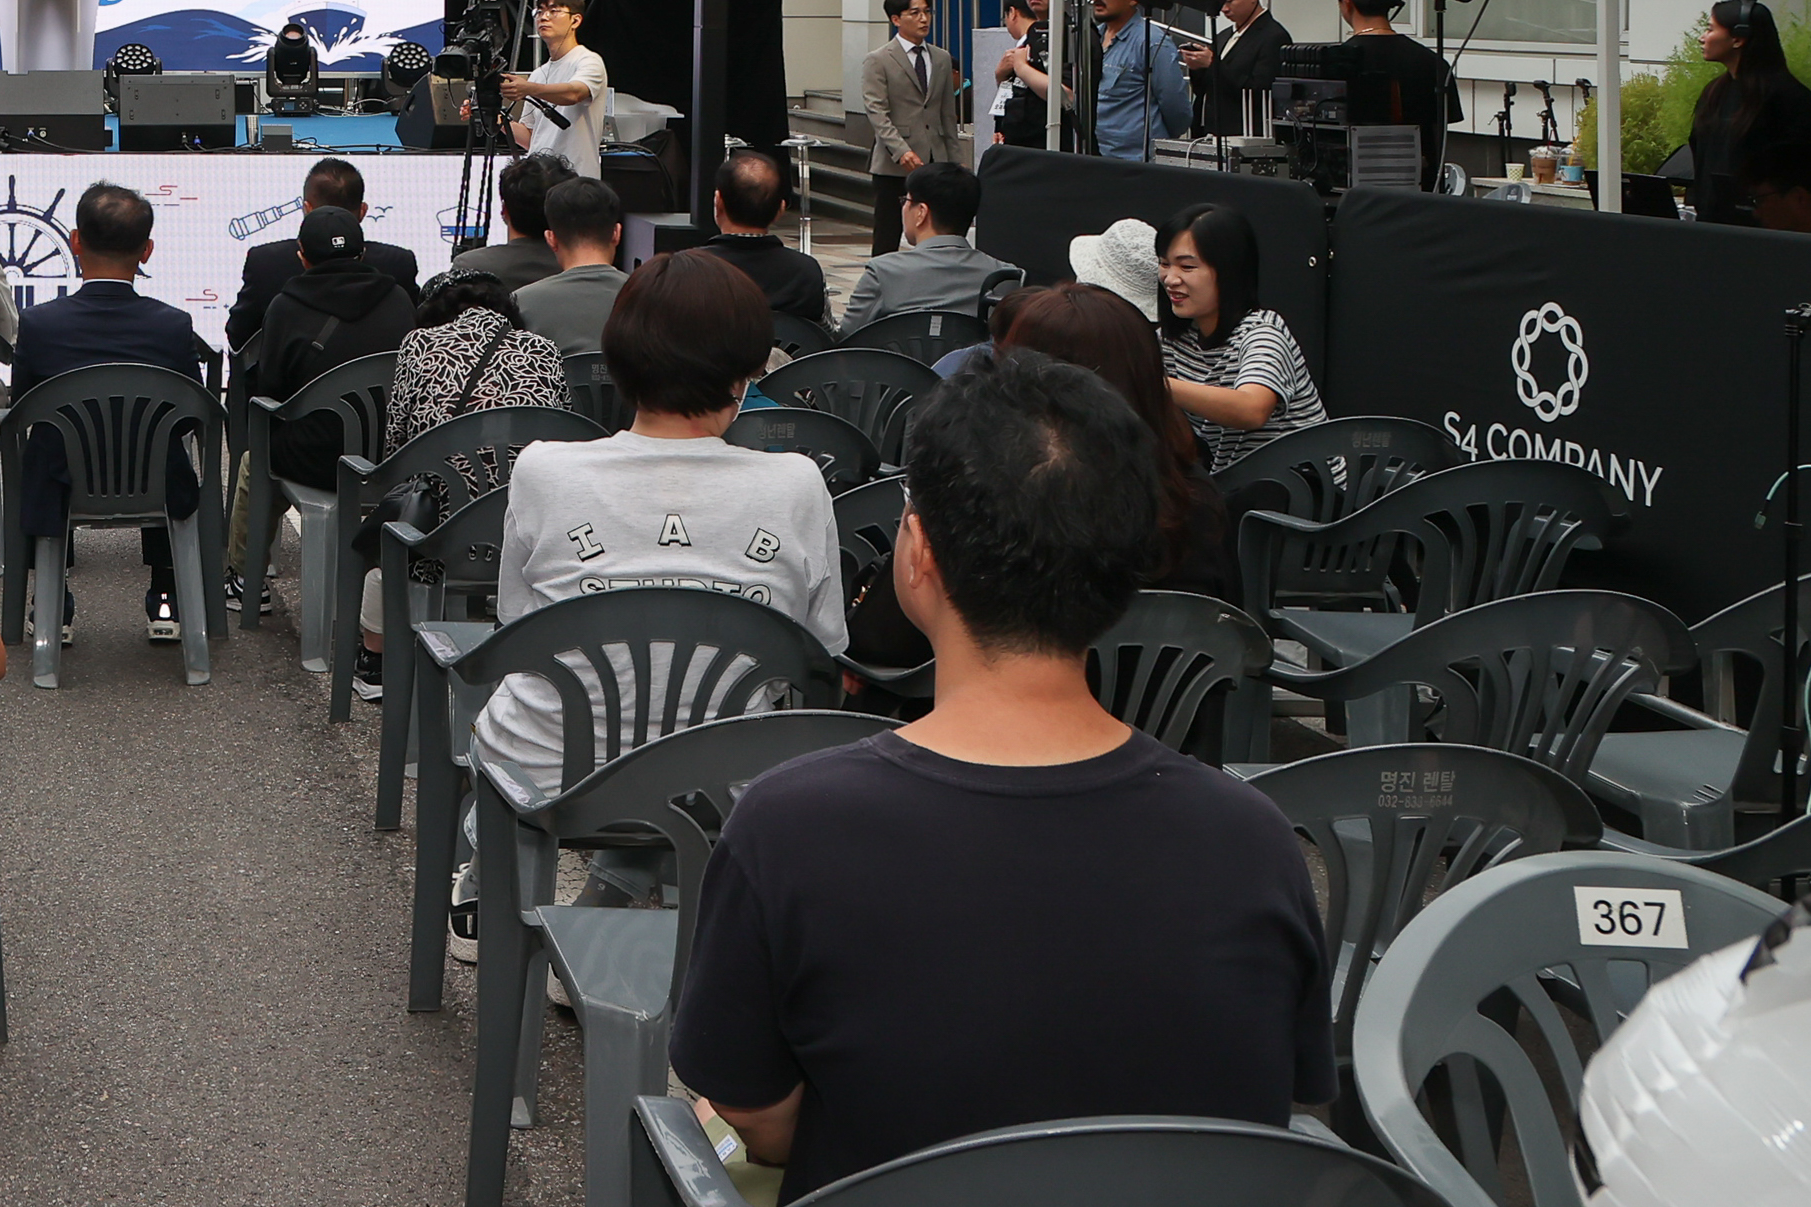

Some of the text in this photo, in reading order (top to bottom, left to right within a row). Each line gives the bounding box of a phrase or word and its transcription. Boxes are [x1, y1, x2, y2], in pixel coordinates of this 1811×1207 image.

[1443, 410, 1664, 507] S4 COMPANY
[1380, 770, 1456, 793] 명진 렌탈
[1593, 899, 1666, 937] 367
